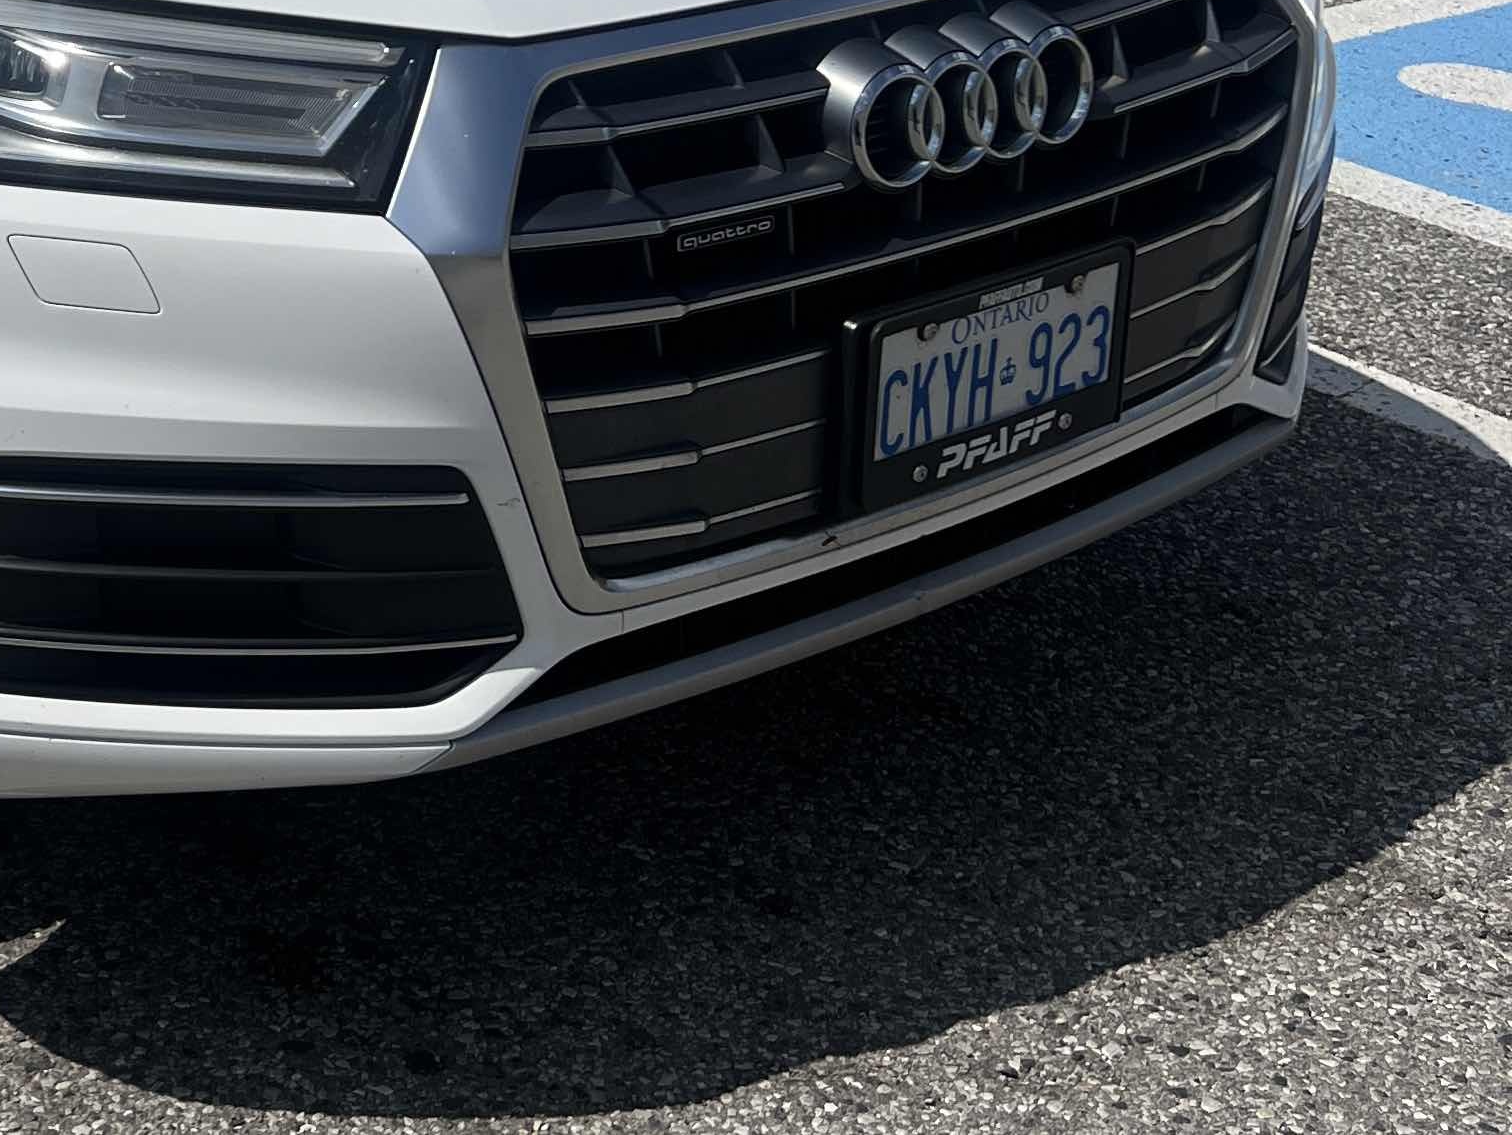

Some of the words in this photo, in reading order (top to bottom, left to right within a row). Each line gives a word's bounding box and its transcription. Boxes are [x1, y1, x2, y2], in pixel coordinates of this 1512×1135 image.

[683, 220, 771, 248] quattro
[951, 292, 1049, 345] ONTARIO
[879, 338, 998, 457] CKYH
[1025, 305, 1110, 406] 923
[937, 409, 1057, 479] PFAFF
